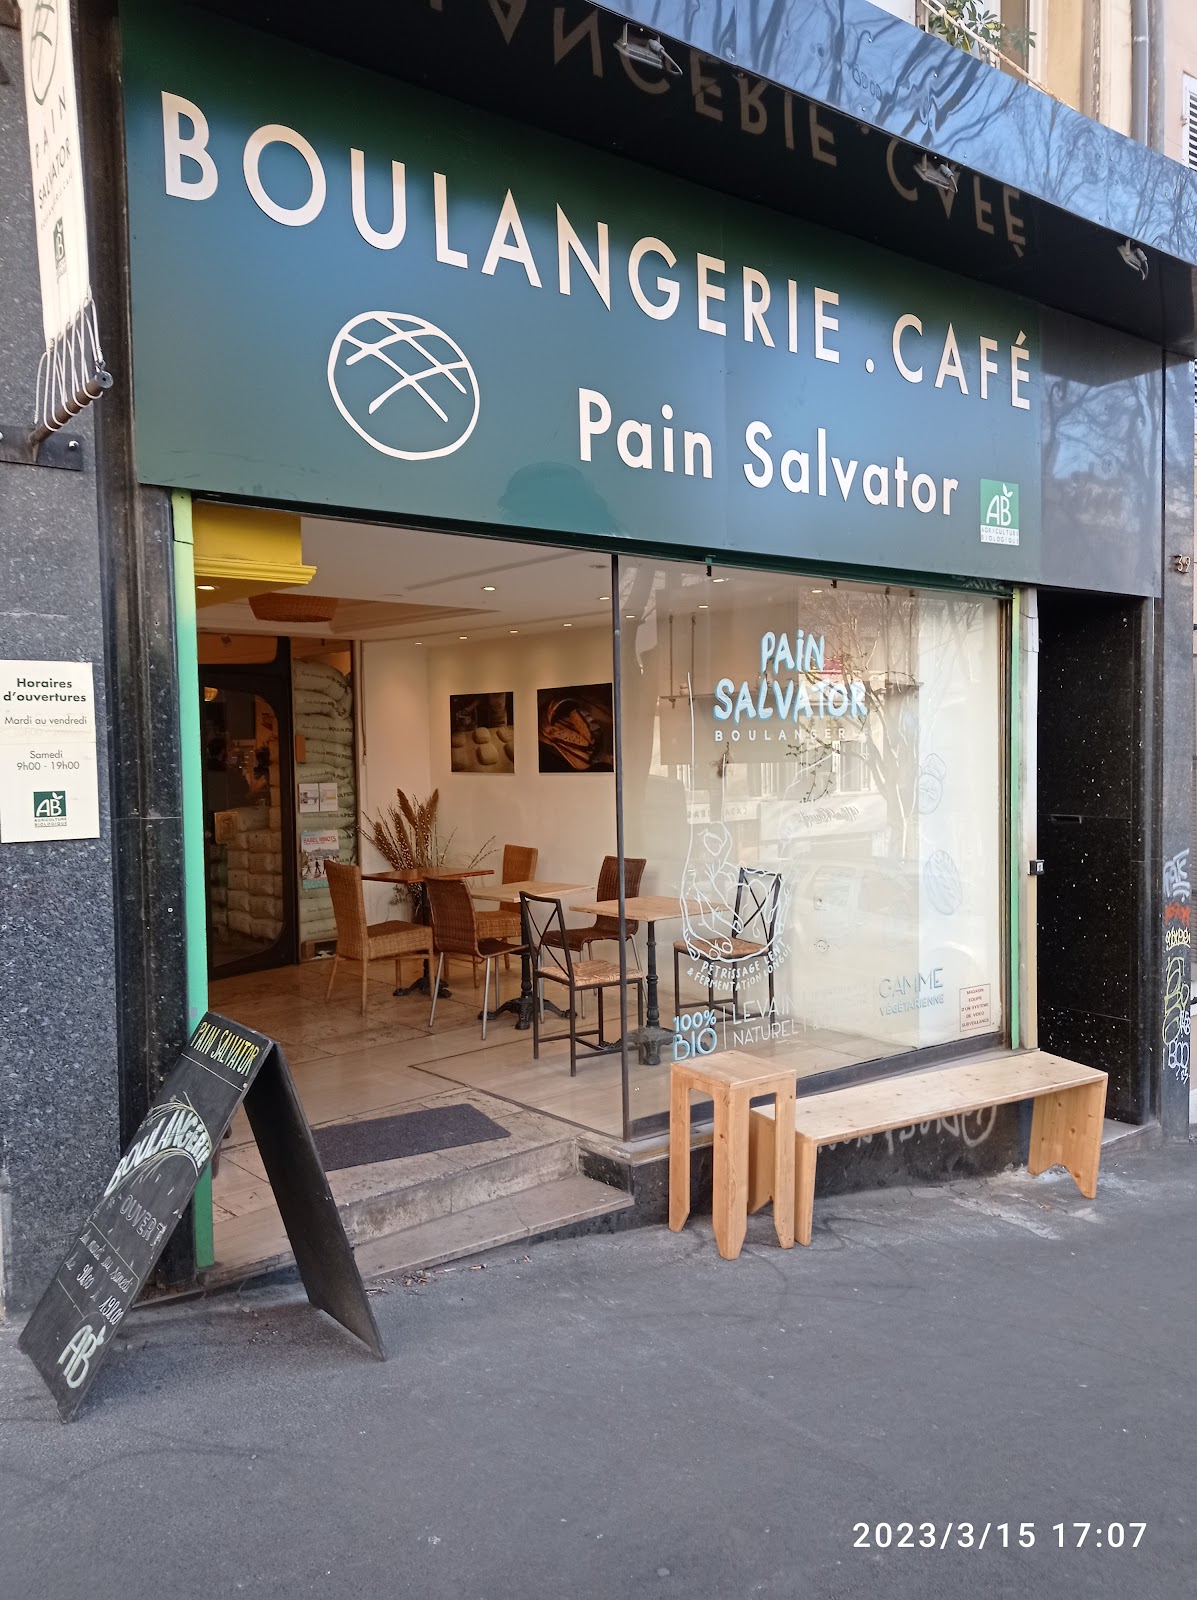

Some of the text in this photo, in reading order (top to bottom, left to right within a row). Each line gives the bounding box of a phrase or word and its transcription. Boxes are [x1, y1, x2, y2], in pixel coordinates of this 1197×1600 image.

[35, 86, 67, 169] PAIN
[38, 137, 71, 210] SALVATOR
[162, 91, 841, 365] BOULANGERIE
[892, 313, 1032, 411] CAFÉ
[578, 387, 960, 517] Pain Salvator
[985, 494, 1013, 526] AB
[981, 527, 1019, 537] AGRICULTURE
[3, 691, 87, 702] d'ouvertures
[16, 678, 73, 688] Horaires
[713, 677, 869, 726] SALVATOR
[4, 716, 32, 725] Mardi
[50, 716, 88, 725] vendredi
[714, 728, 869, 742] BOULANGERE
[16, 761, 41, 771] 9h00
[51, 761, 80, 771] 19h00
[29, 750, 63, 759] Samedi
[35, 798, 63, 817] AB
[763, 937, 786, 965] LENT
[763, 945, 792, 977] LONGUE
[879, 967, 944, 999] GAMME
[672, 1008, 717, 1034] 100%
[732, 994, 801, 1026] LEVAIN
[961, 1018, 989, 1027] SURVEILLANCE
[190, 1022, 260, 1077] PAIN SALVATOR
[672, 1018, 799, 1062] BIO NATUREL
[119, 1195, 167, 1246] OUVERT
[58, 1324, 97, 1389] AB
